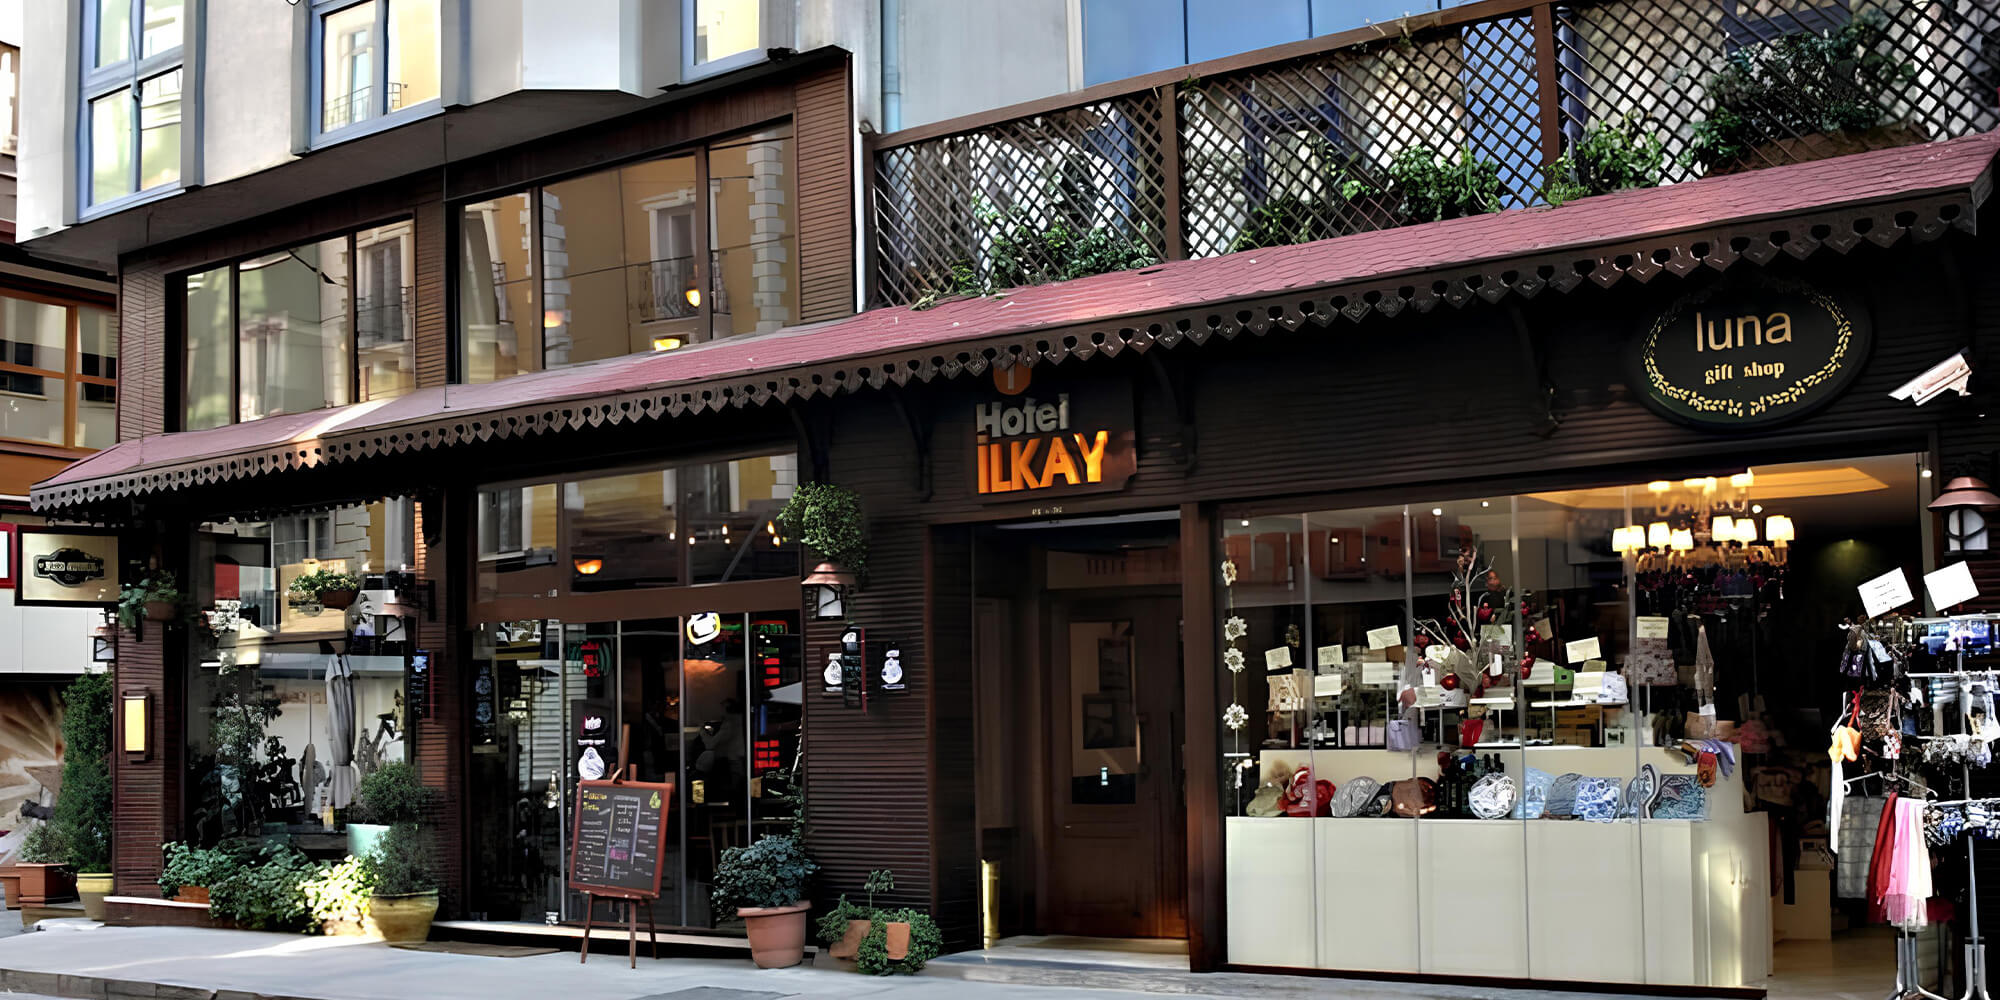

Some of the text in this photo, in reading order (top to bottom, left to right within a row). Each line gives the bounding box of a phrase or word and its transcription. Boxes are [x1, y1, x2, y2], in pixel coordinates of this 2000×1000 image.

[1696, 312, 1792, 352] luna
[1705, 361, 1785, 385] gift shop
[976, 392, 1070, 438] Hotel
